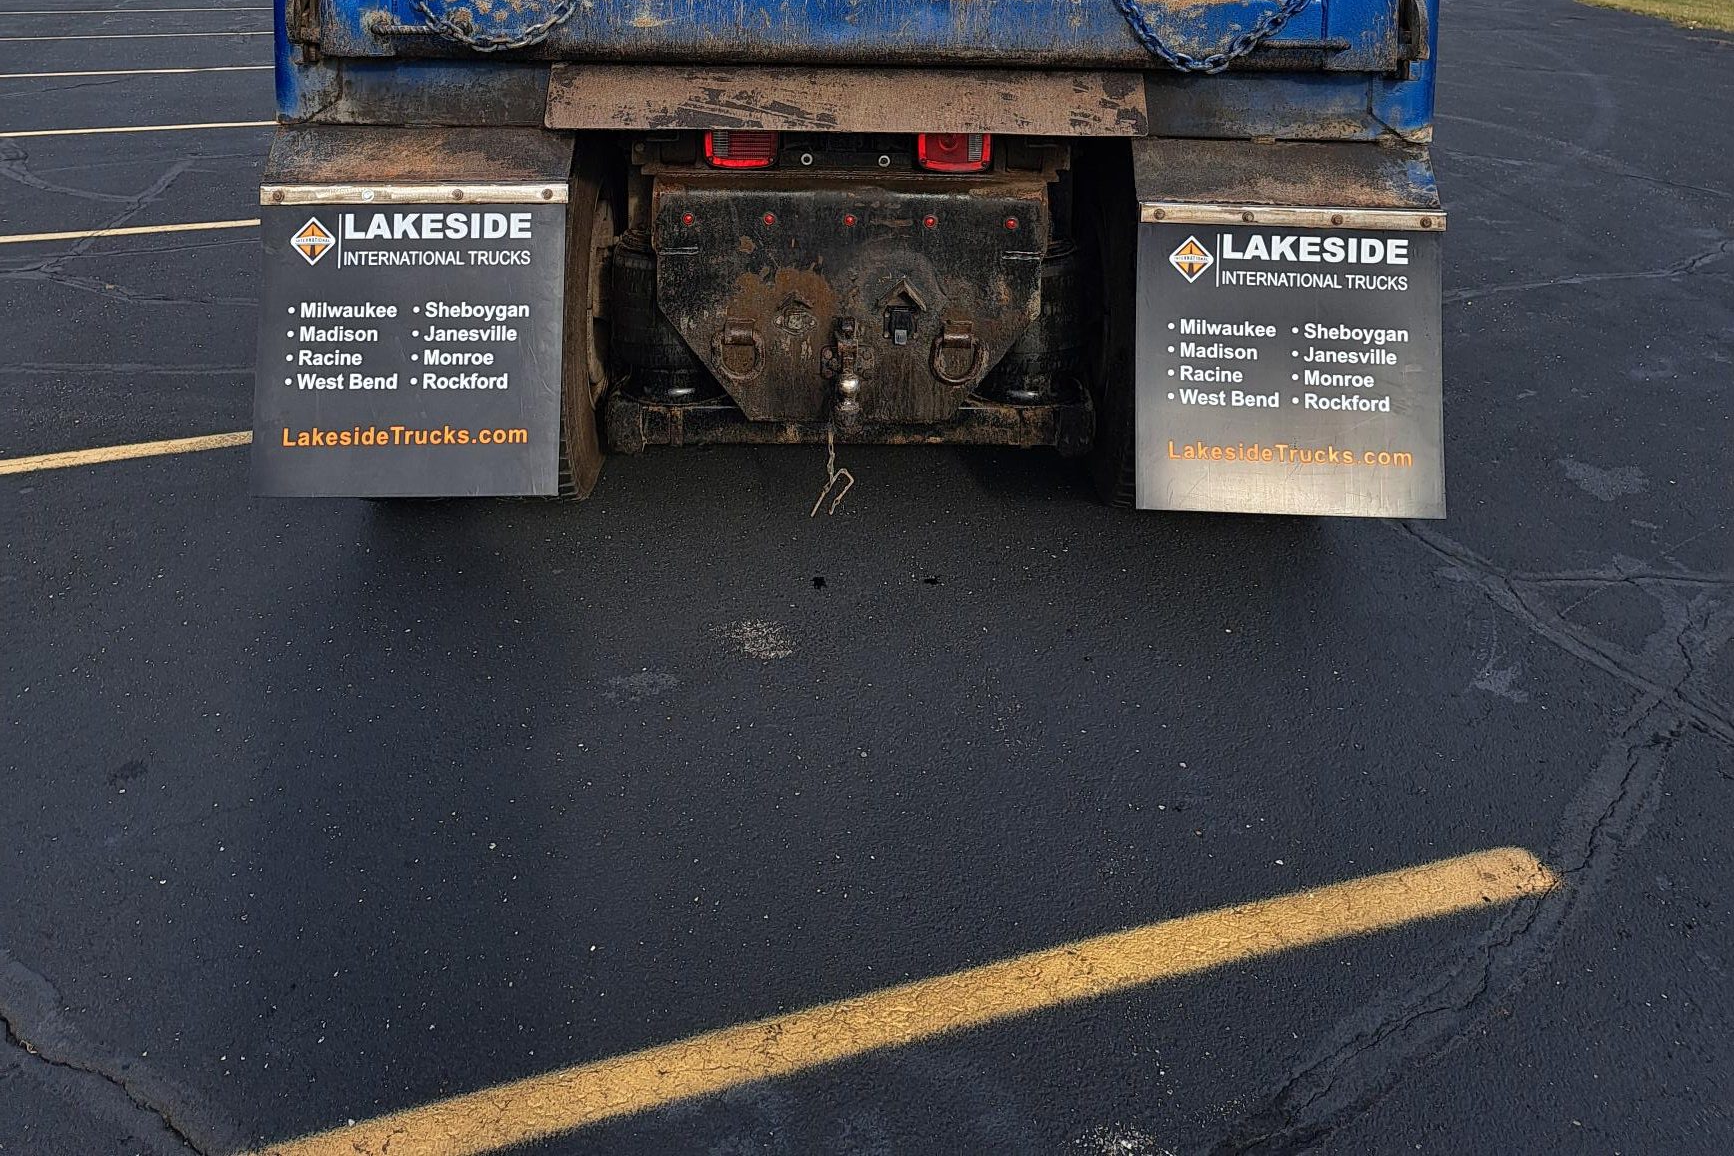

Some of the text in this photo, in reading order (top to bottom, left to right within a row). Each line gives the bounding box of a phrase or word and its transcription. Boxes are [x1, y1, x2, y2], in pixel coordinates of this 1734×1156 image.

[344, 213, 532, 240] LAKESIDE
[343, 250, 531, 266] INTERNATIONAL TRUCKS
[1222, 233, 1409, 265] LAKESIDE
[1221, 270, 1408, 291] INTERNATIONAL TRUCKS
[300, 302, 398, 319] Milwaukee
[424, 301, 530, 322] Sheboygan
[299, 325, 378, 342] Madison
[423, 325, 518, 342] Janesville
[1179, 318, 1277, 338] Milwaukee
[1303, 323, 1409, 346] Sheboygan
[298, 349, 363, 366] Racine
[423, 349, 495, 366] Monroe
[1179, 342, 1258, 360] Madison
[1303, 347, 1397, 365] Janesville
[297, 373, 398, 390] West Bend
[422, 373, 508, 390] Rockford
[1179, 365, 1243, 383] Racine
[1304, 370, 1375, 389] Monroe
[1179, 388, 1280, 408] West Bend
[1304, 393, 1390, 413] Rockford
[282, 426, 529, 447] LakesideTrucks.com
[1167, 440, 1414, 468] LakesideTrucks.com
